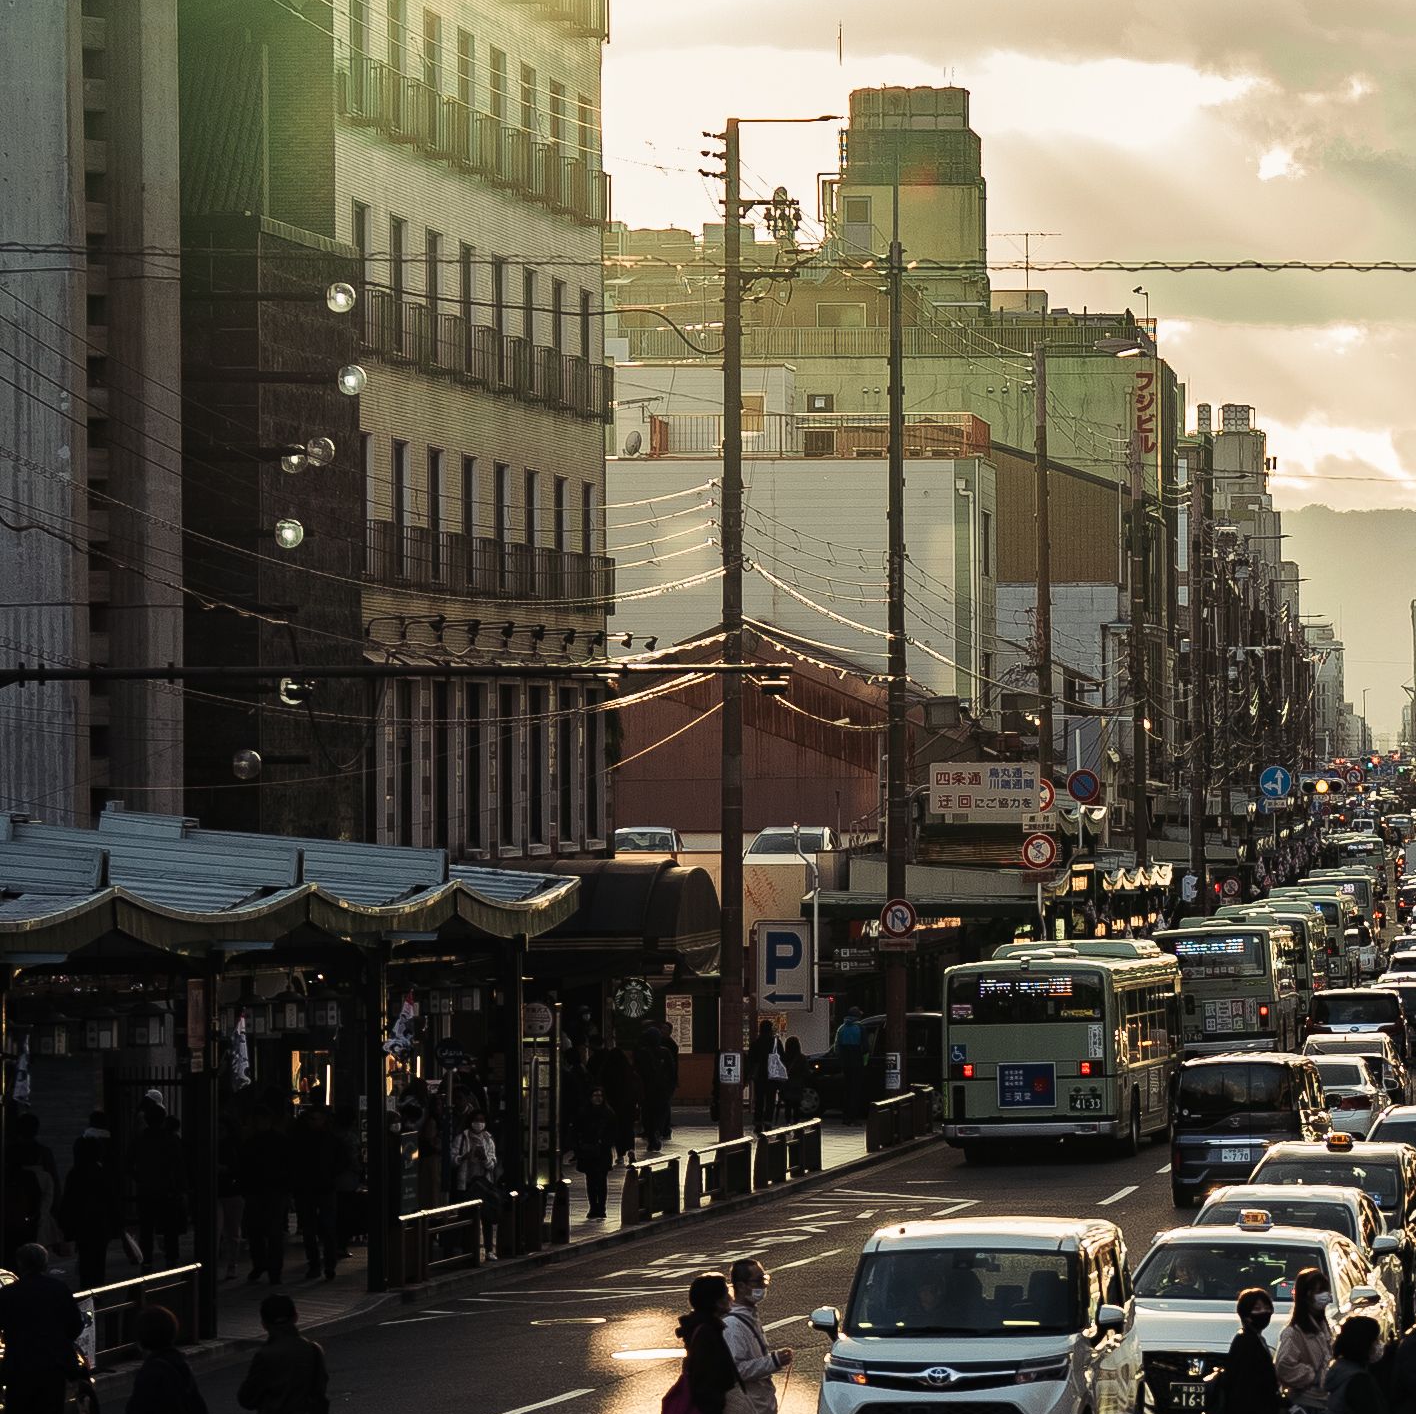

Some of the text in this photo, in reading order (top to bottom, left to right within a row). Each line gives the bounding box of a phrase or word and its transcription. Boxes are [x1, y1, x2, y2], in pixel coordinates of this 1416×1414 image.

[1135, 371, 1156, 454] フジビル
[935, 771, 981, 786] 四条通
[765, 931, 803, 986] P
